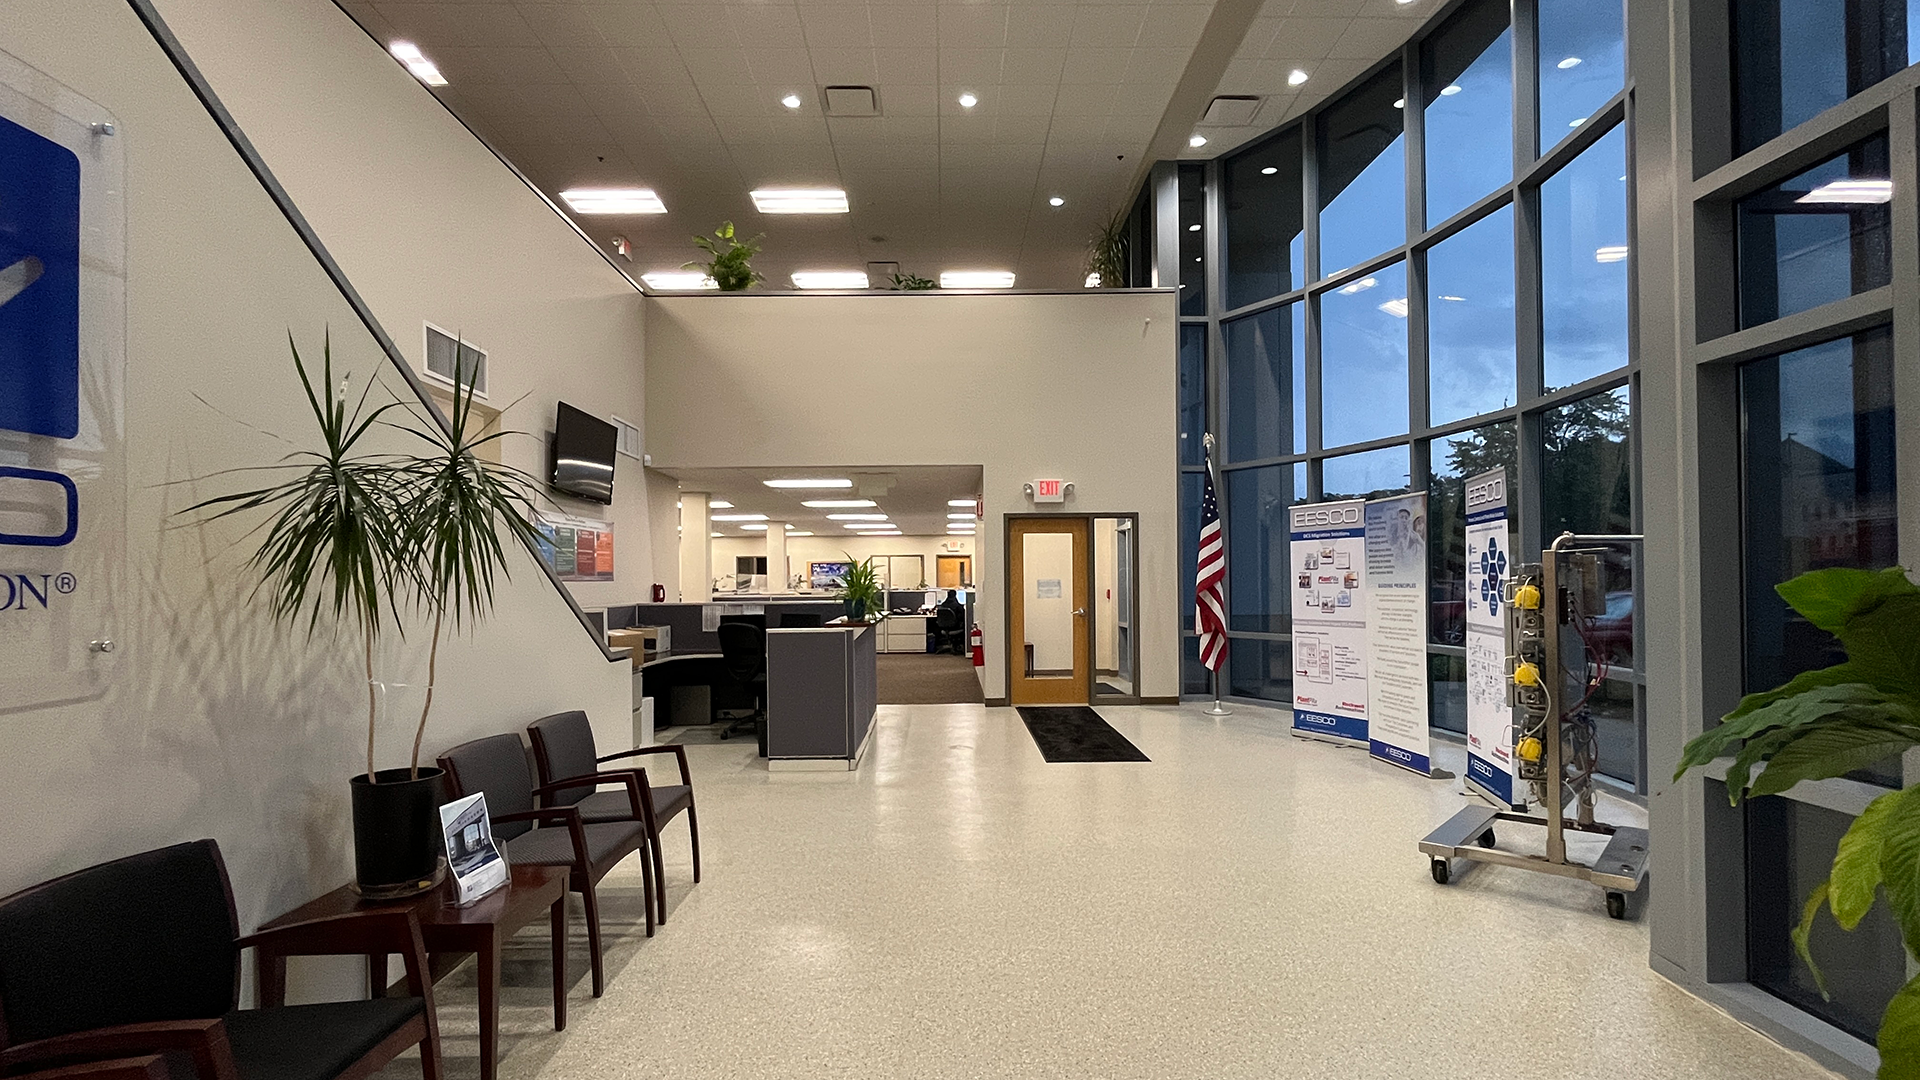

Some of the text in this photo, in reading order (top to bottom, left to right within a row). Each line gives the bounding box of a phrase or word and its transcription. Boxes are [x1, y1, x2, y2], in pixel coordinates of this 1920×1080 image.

[1039, 481, 1060, 496] EXIT
[1469, 478, 1503, 507] EESCO
[1294, 507, 1359, 527] EESCO
[1306, 714, 1336, 726] EESCO
[1389, 747, 1412, 762] EESCO
[1474, 760, 1493, 778] EESCO
